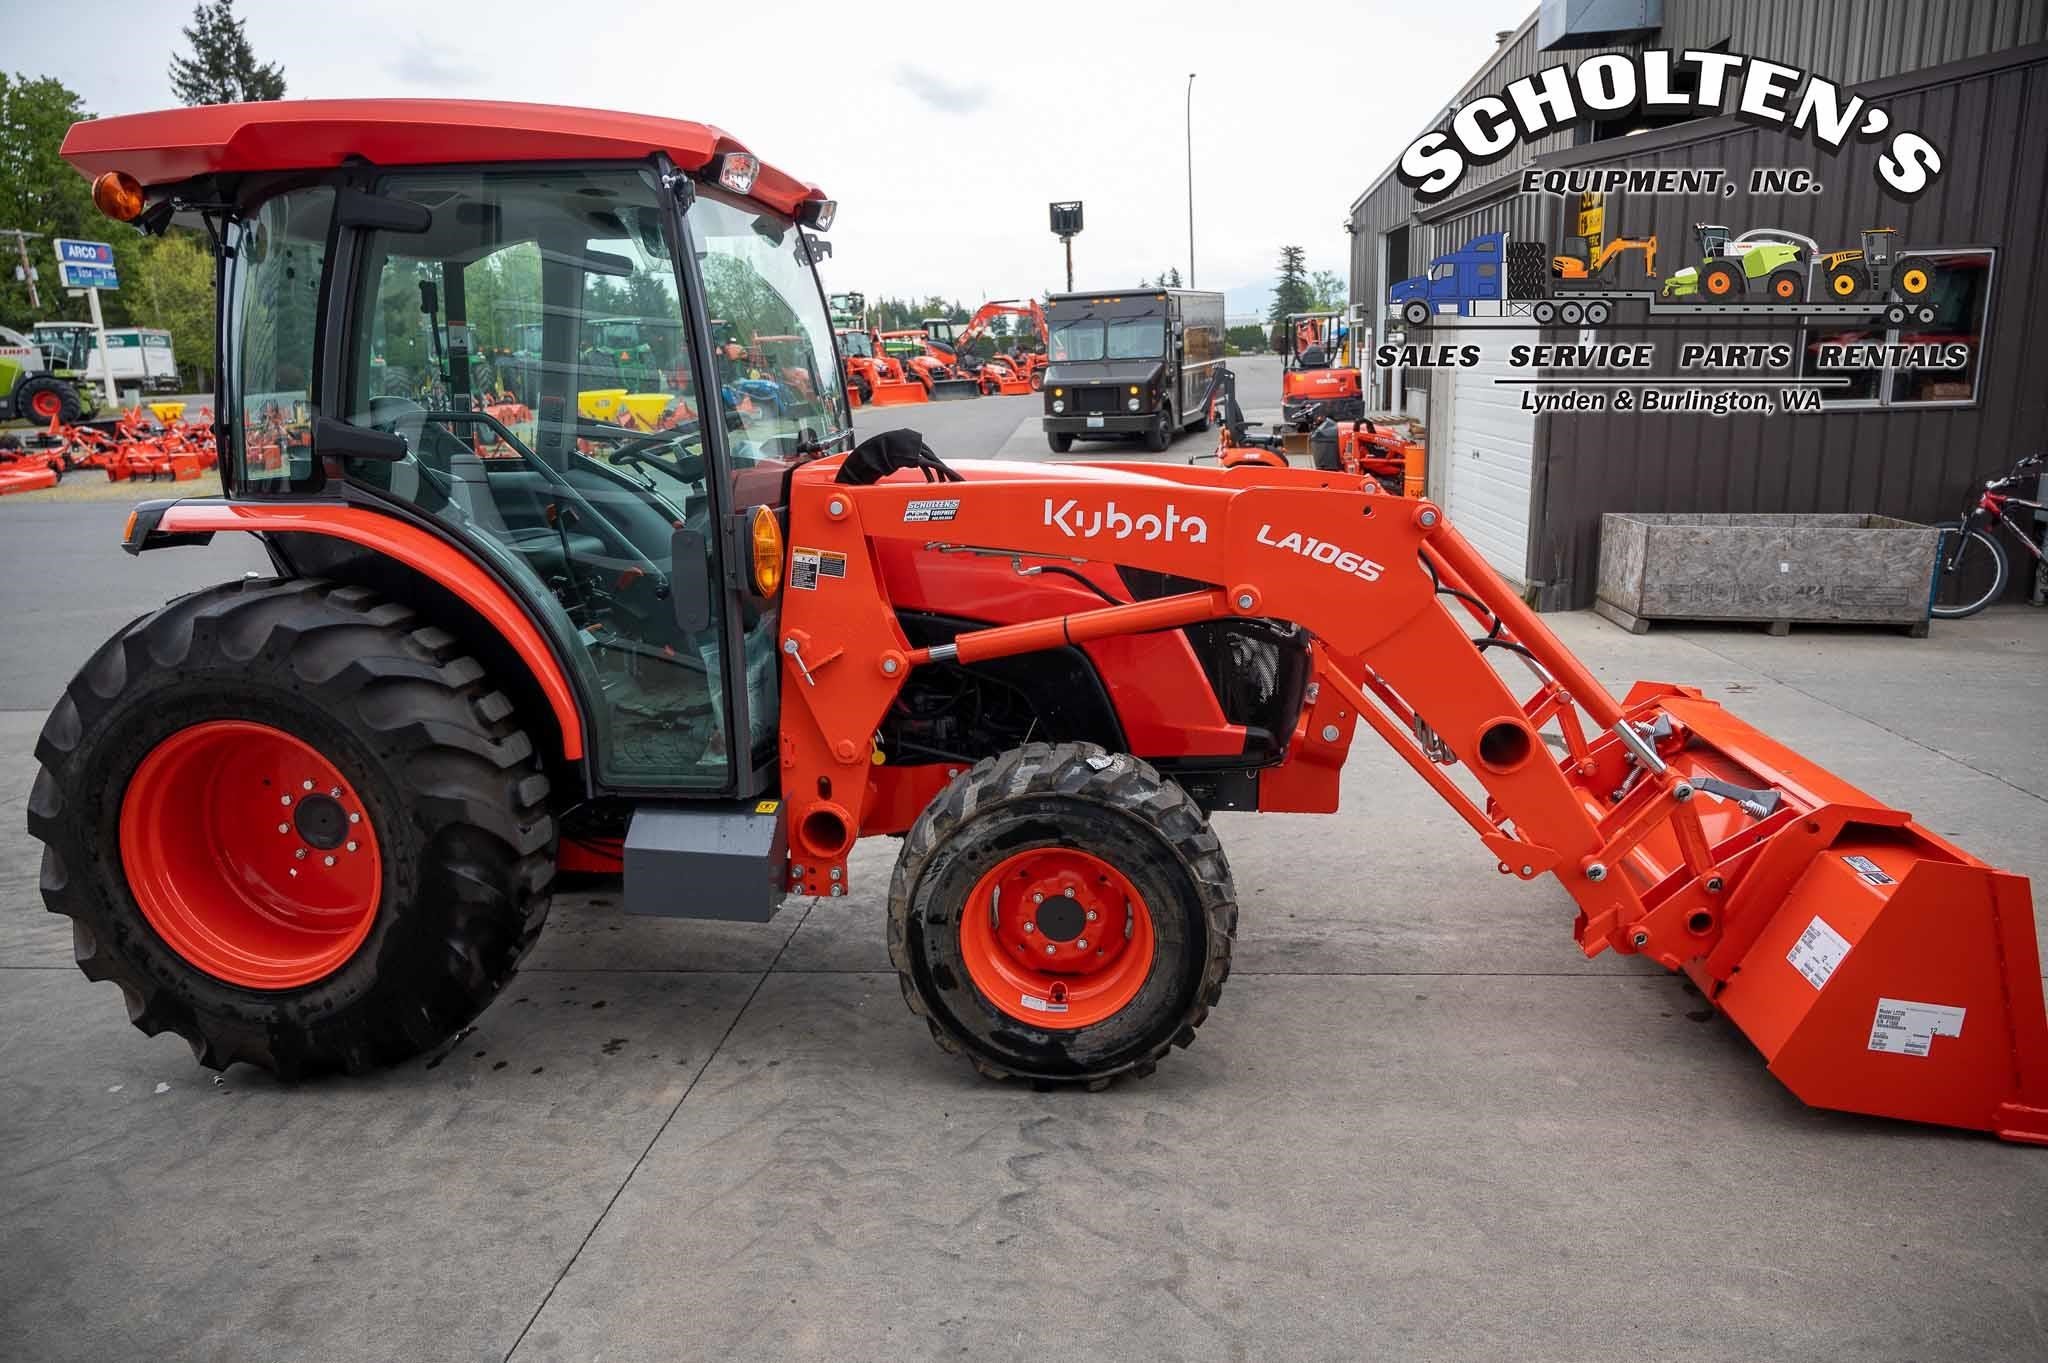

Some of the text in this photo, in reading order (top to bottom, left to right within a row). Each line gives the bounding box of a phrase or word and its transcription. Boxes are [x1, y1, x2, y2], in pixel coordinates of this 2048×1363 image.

[68, 245, 97, 259] ARCO
[1043, 498, 1208, 544] Kubota
[1256, 524, 1385, 582] LA1065
